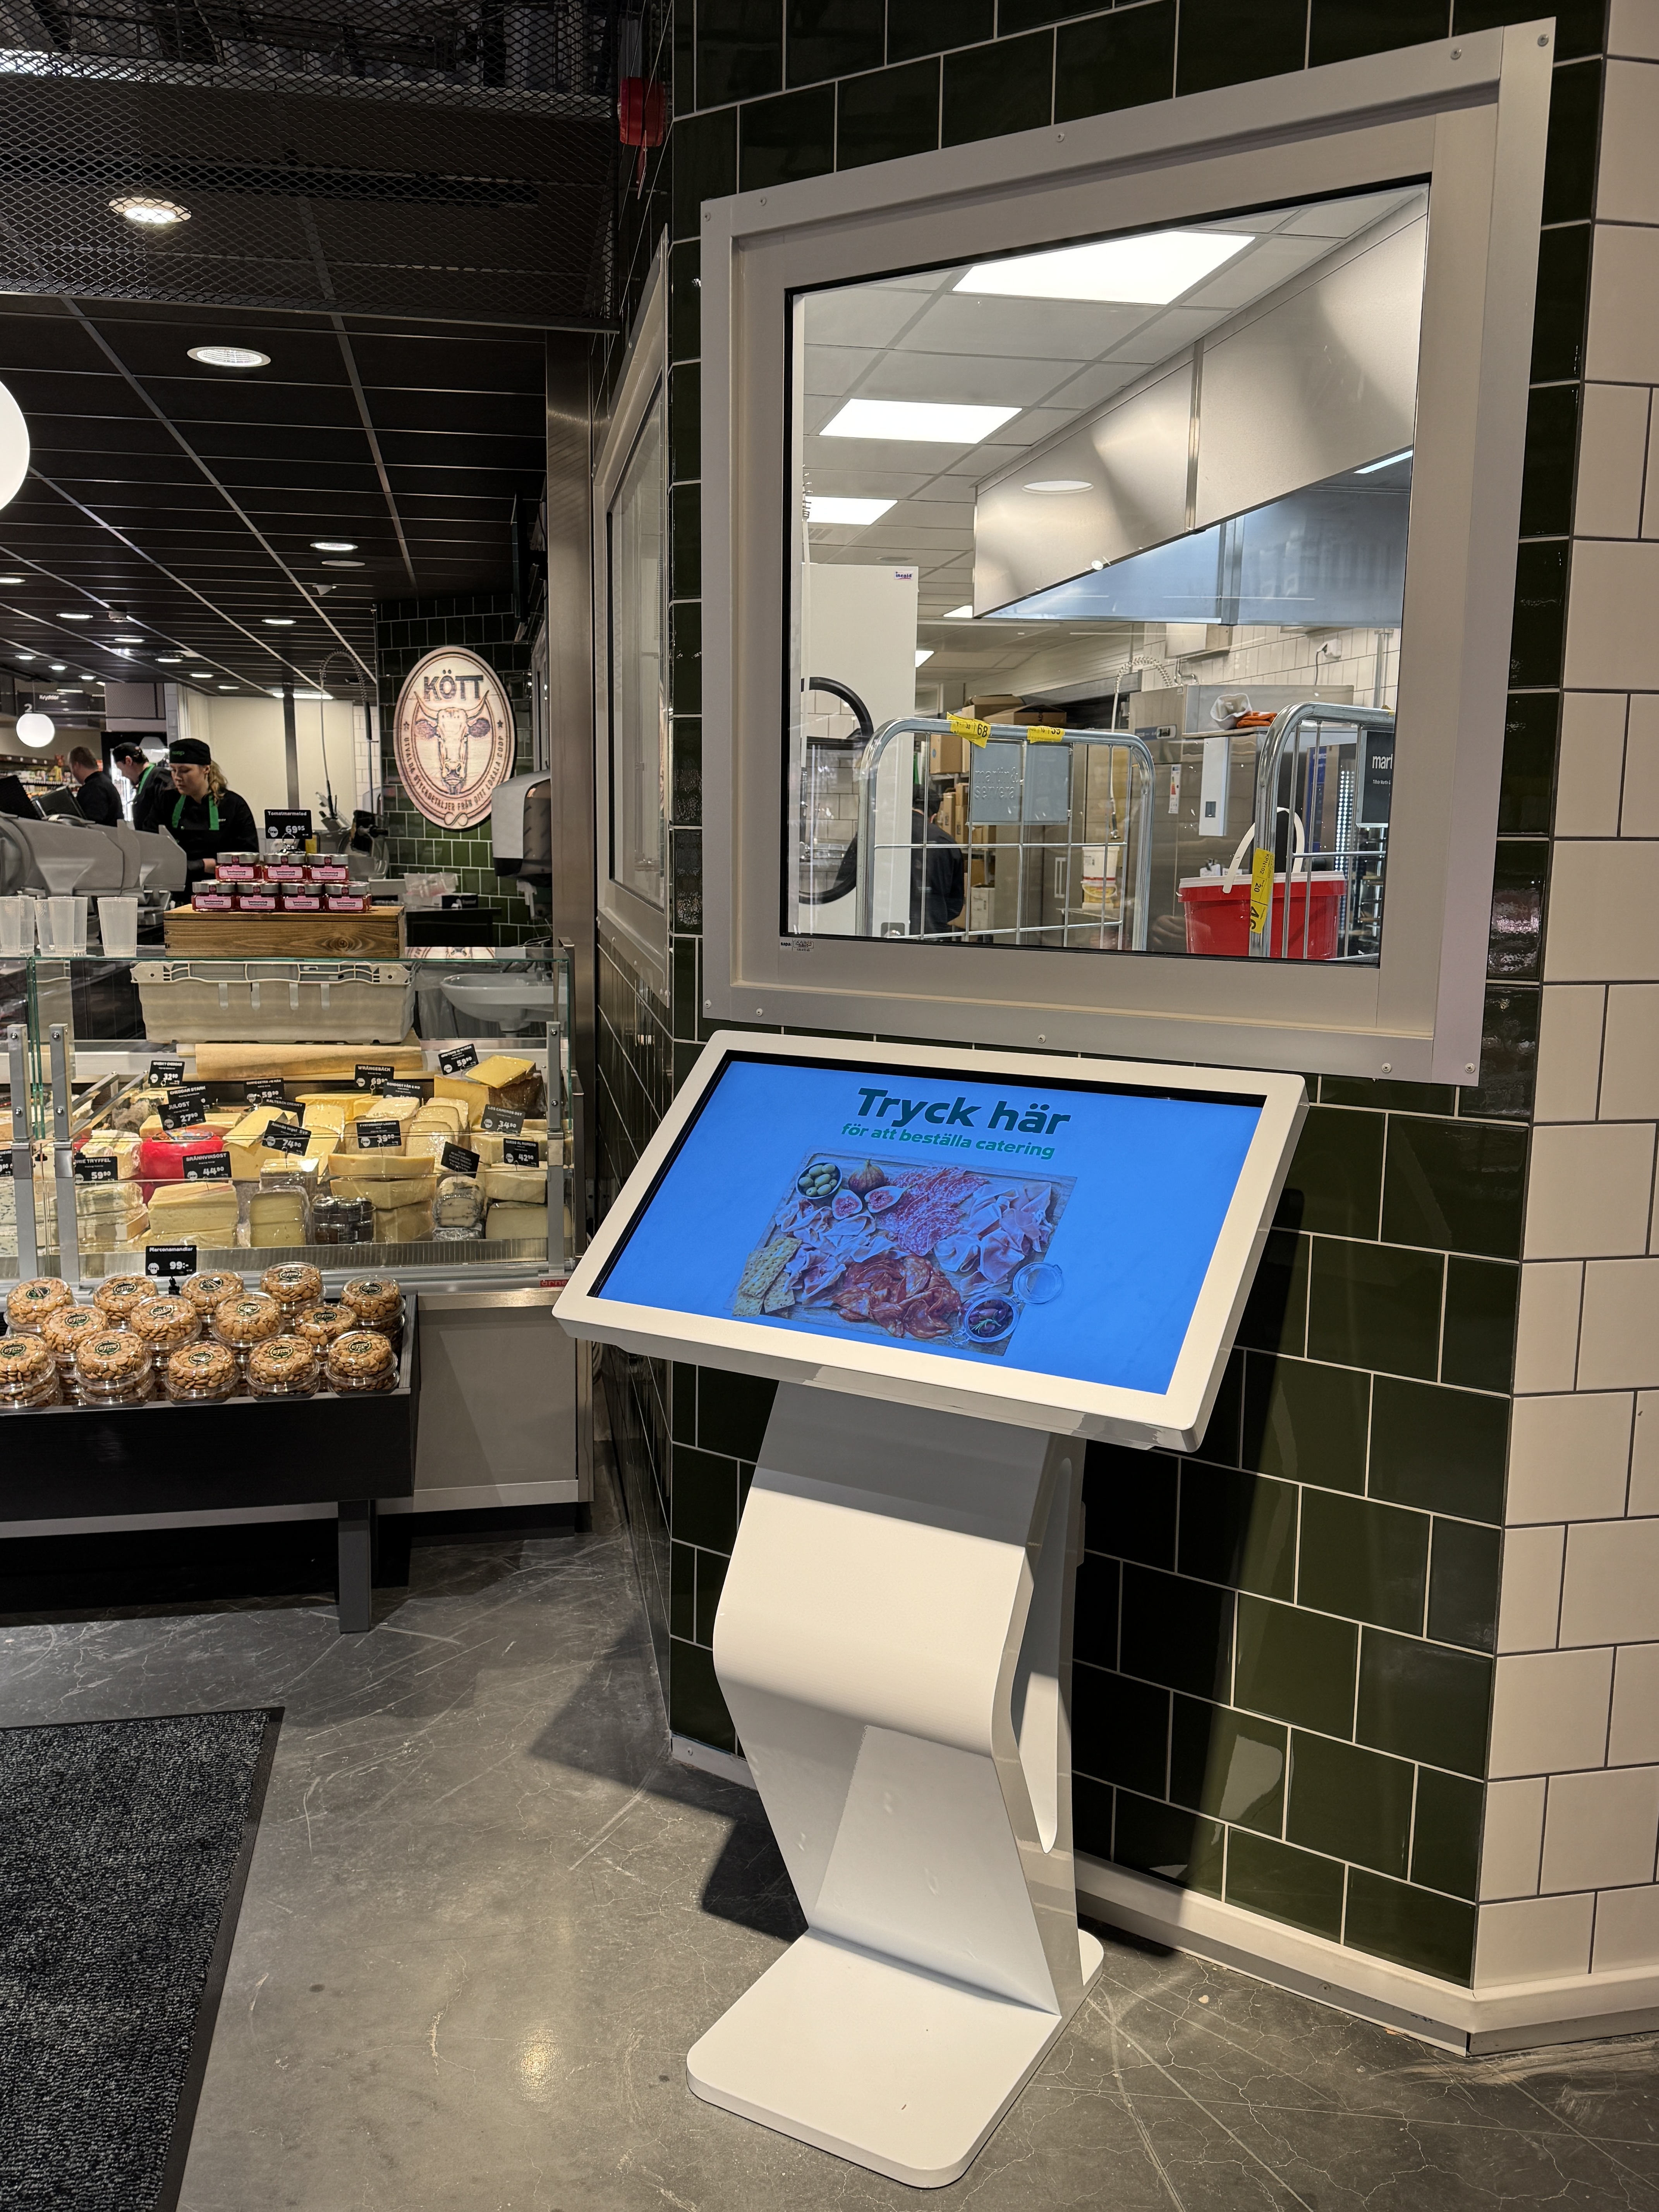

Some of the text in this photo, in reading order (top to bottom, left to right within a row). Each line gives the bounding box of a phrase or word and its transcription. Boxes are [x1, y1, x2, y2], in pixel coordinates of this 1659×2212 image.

[424, 669, 484, 701] KÖTT
[24, 703, 33, 713] 2
[977, 723, 988, 738] 68
[404, 737, 416, 774] UTVALDA
[414, 775, 455, 811] STYCKDETALJER
[458, 800, 472, 810] FRÅN
[474, 788, 487, 804] DITT
[485, 761, 501, 790] LOKALA
[1260, 854, 1269, 874] KPN102
[1254, 883, 1261, 892] 20
[168, 1101, 190, 1110] JULOST
[857, 1087, 1072, 1135] Tryck här
[841, 1123, 1055, 1161] för att beställa catering
[170, 1261, 189, 1270] 99:-
